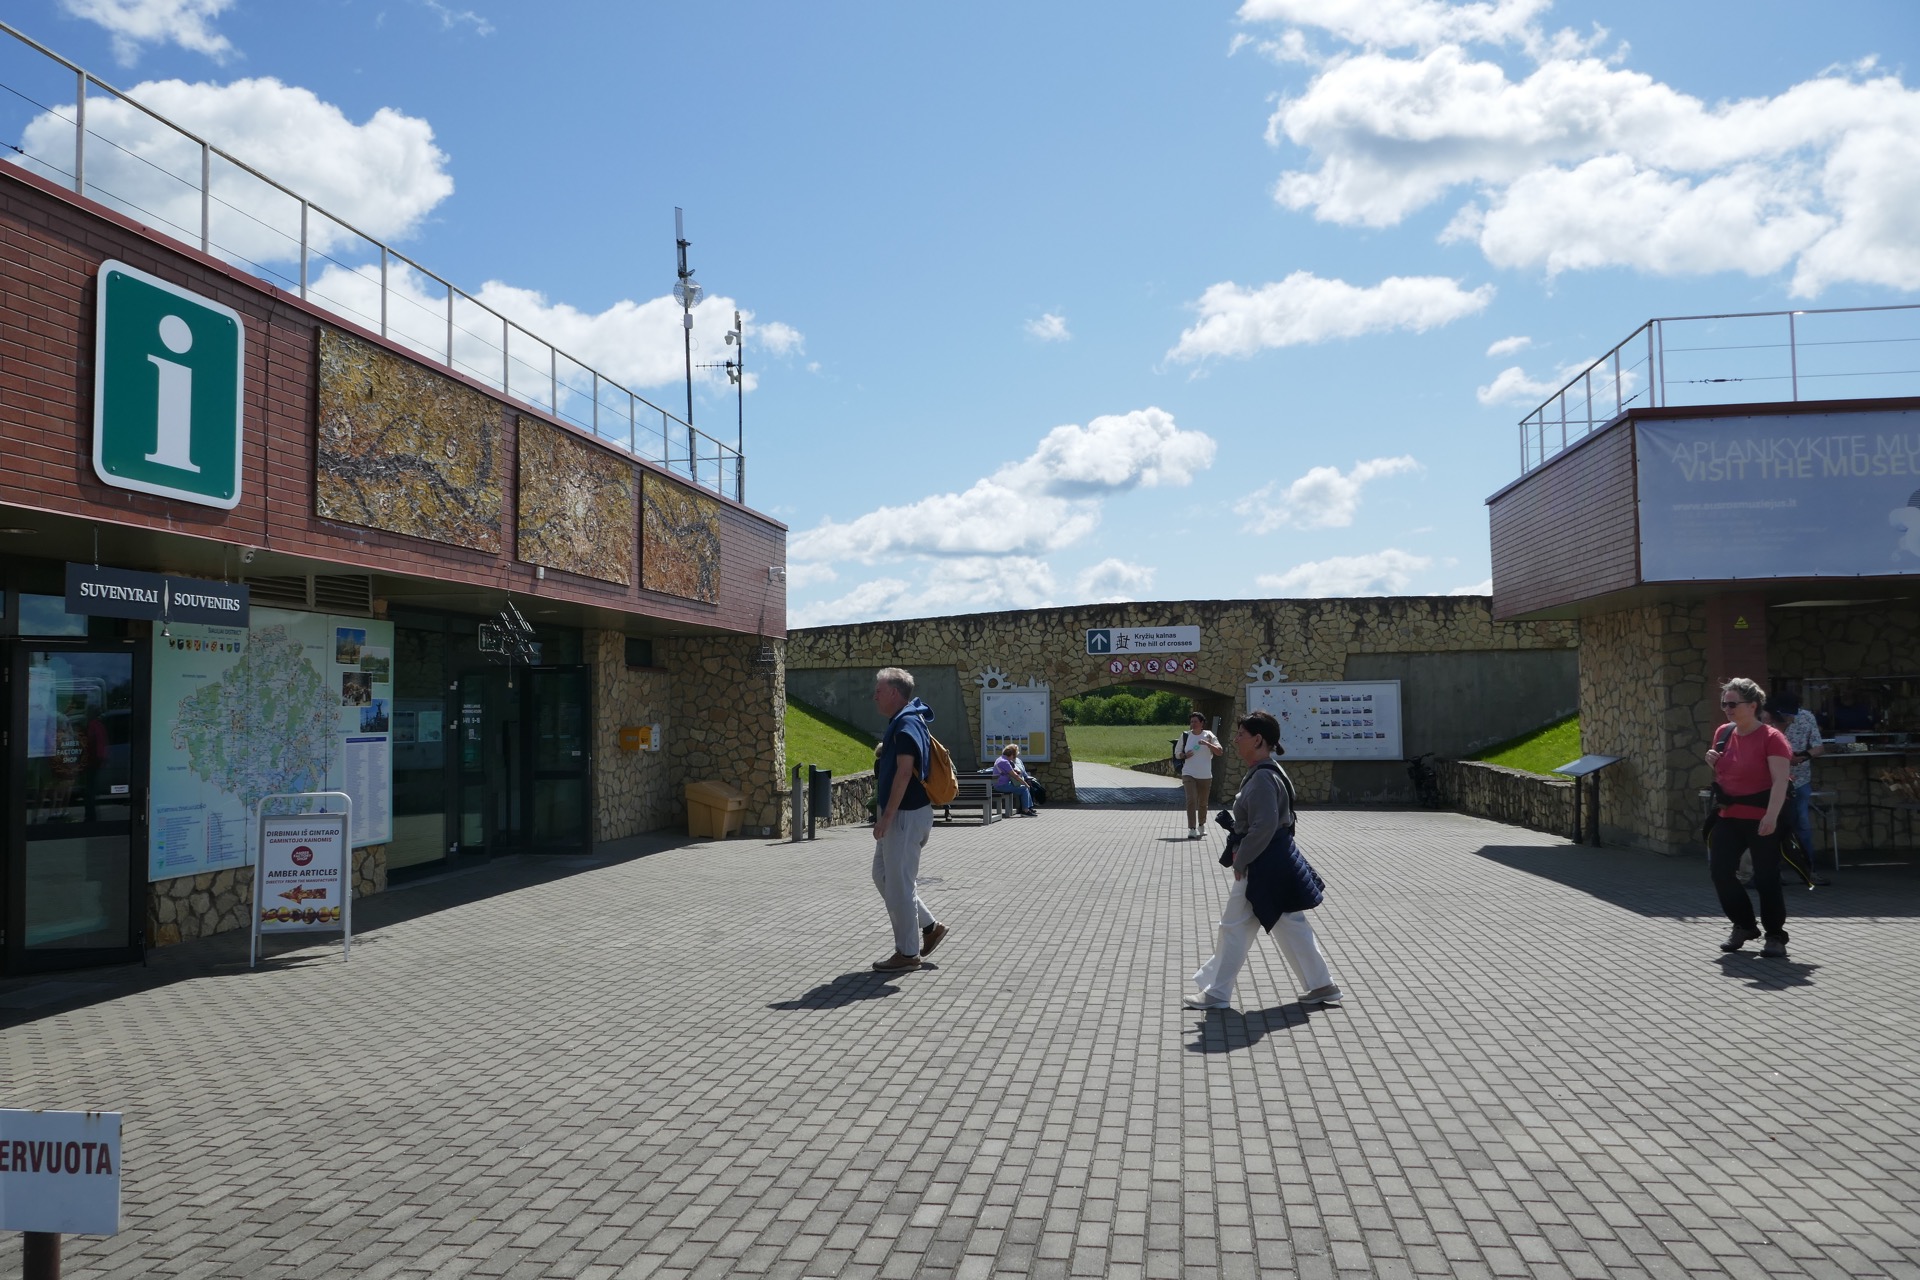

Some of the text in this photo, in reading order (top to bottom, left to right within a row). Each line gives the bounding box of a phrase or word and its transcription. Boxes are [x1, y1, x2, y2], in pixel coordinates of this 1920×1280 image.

[1672, 435, 1866, 463] APLANKYKITE
[1679, 460, 1747, 482] VISIT
[1756, 457, 1813, 479] THE
[80, 582, 240, 611] SUVENYRAI SOUVENIRS
[267, 870, 298, 878] AMBER
